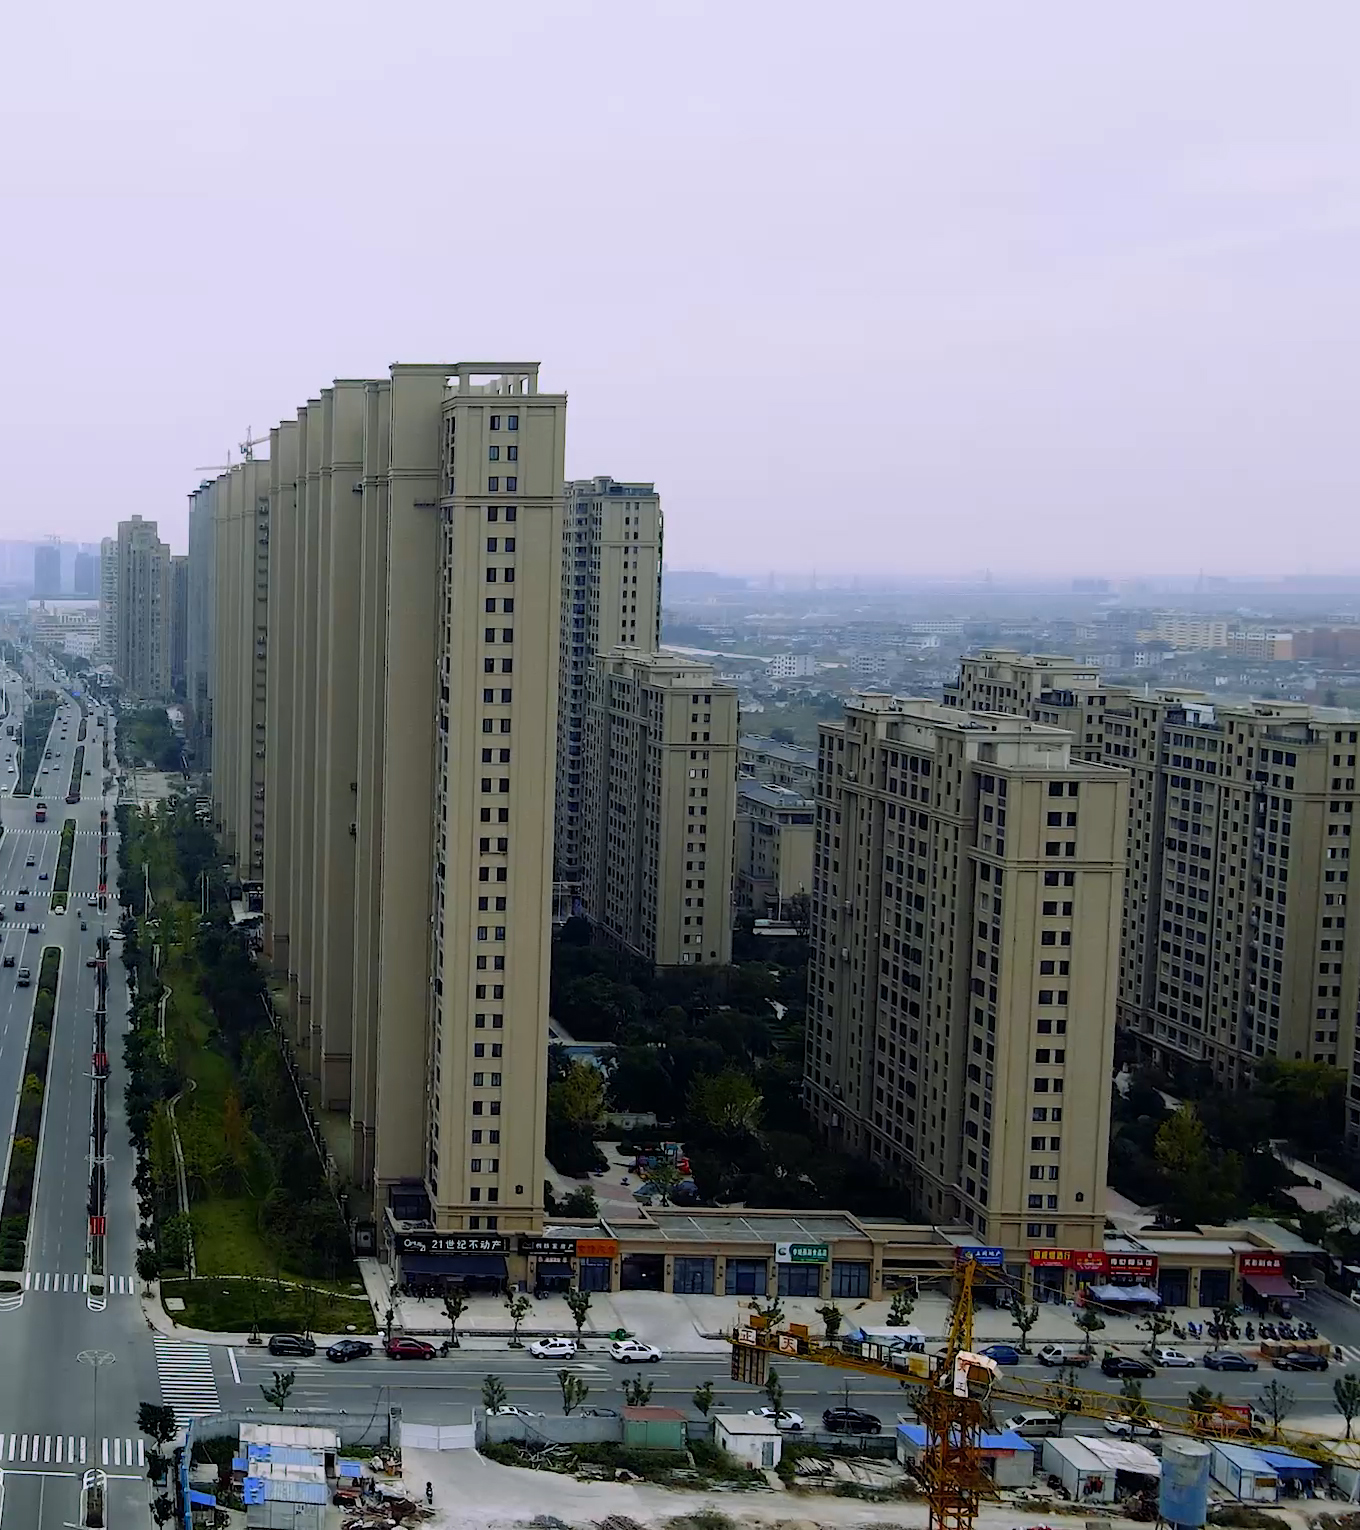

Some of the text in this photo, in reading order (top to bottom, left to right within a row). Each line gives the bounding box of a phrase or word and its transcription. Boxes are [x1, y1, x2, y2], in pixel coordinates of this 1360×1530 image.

[431, 1239, 502, 1250] 21世纪不动产
